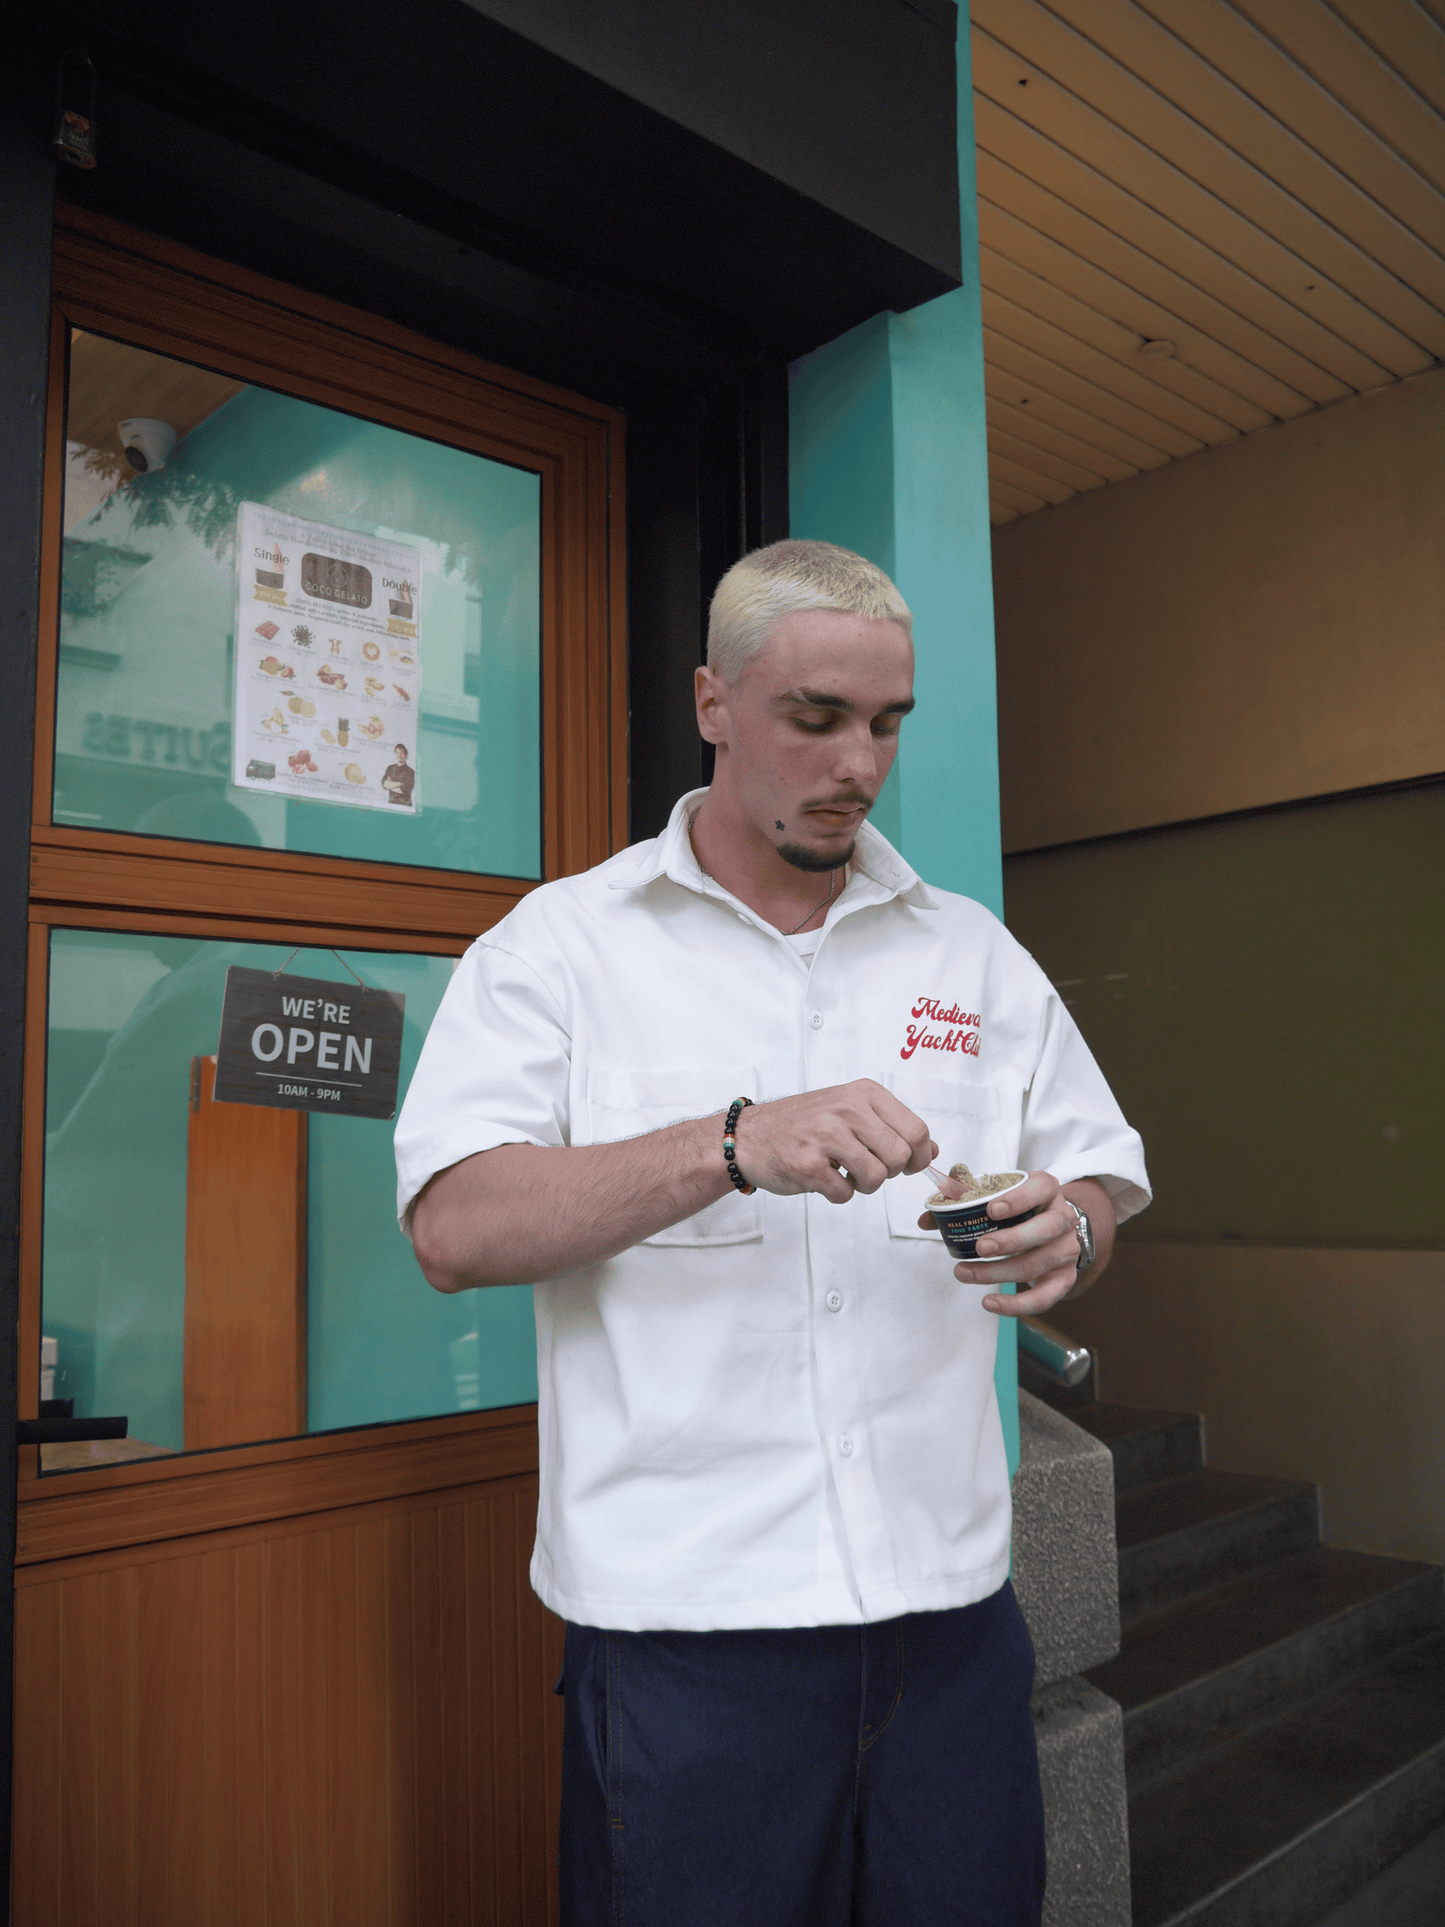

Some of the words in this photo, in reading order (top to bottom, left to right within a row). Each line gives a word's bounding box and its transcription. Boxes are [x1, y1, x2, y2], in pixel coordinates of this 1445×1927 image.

[254, 547, 290, 566] Single
[305, 581, 333, 596] COCO
[334, 588, 368, 605] GELATO
[382, 577, 418, 595] Double
[282, 996, 351, 1025] WE’RE
[251, 1022, 373, 1075] OPEN
[900, 1024, 962, 1060] Yacht
[277, 1084, 308, 1097] 10AM
[316, 1087, 341, 1101] 9PM
[963, 1216, 989, 1227] FRUITS
[967, 1222, 989, 1232] TASTE
